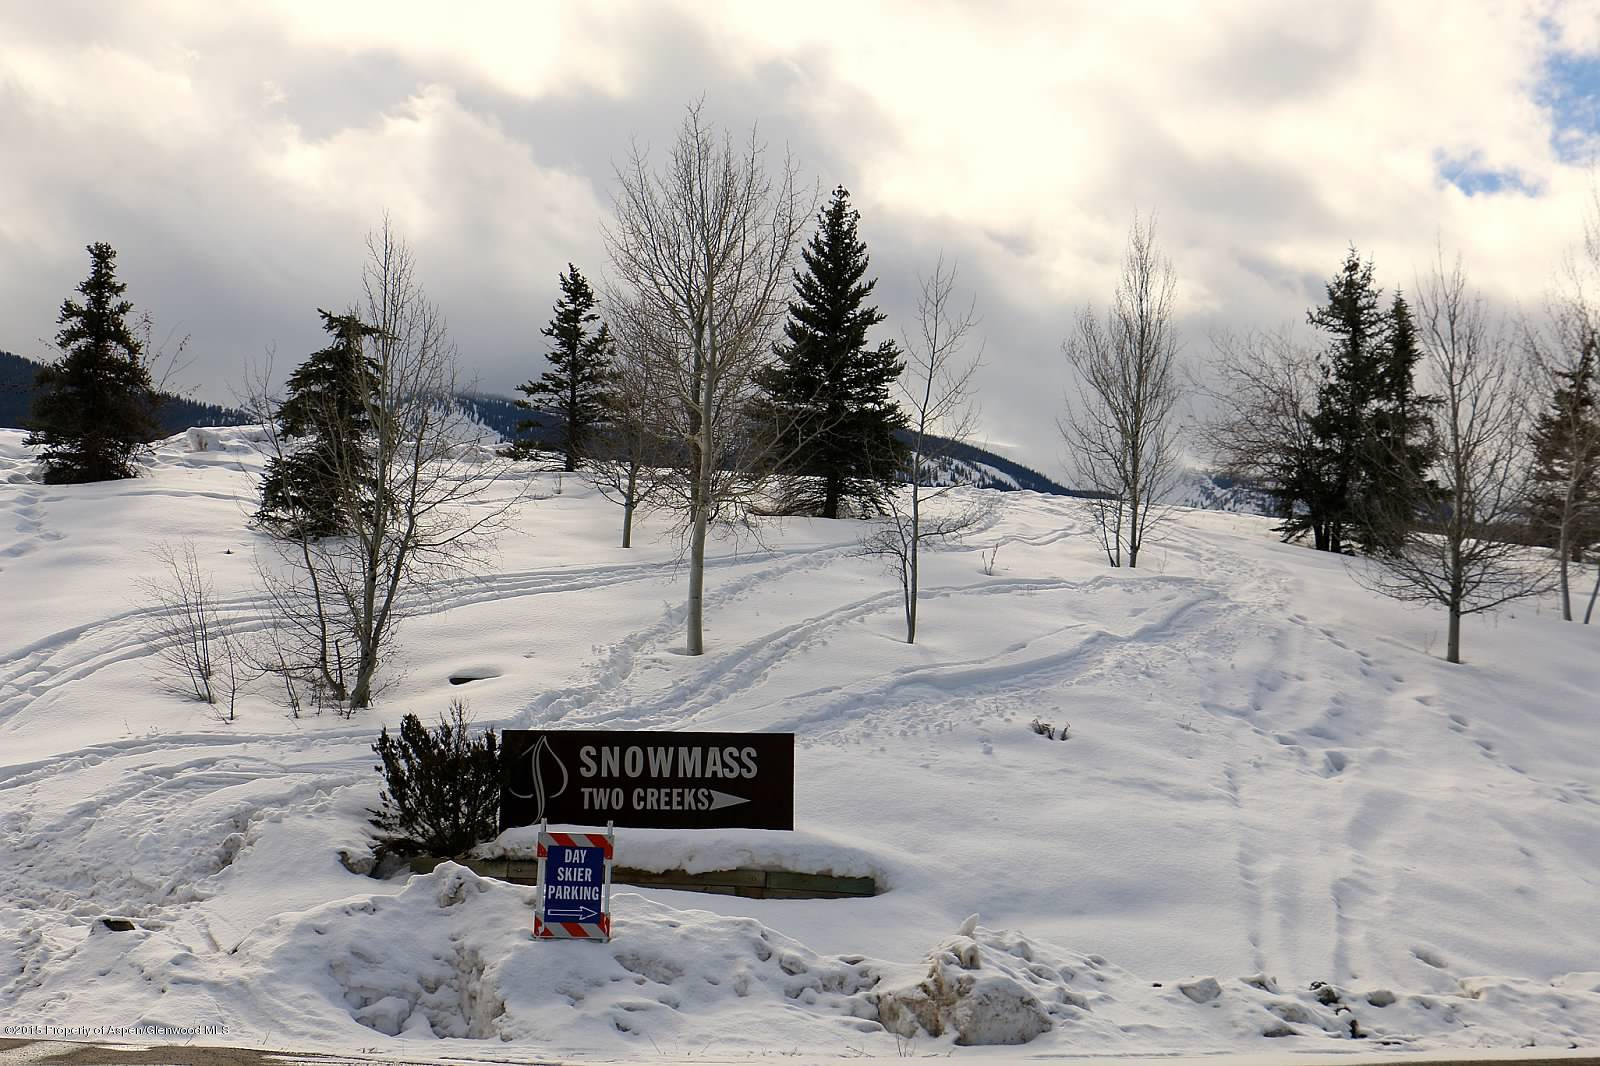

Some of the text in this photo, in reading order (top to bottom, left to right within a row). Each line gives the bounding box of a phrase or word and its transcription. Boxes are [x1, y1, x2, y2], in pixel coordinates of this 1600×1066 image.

[579, 745, 758, 779] SNOWMASS
[580, 787, 709, 811] TWO CREEKS
[564, 848, 587, 864] DAY
[557, 867, 592, 882] SKIER
[547, 885, 600, 901] PARKING
